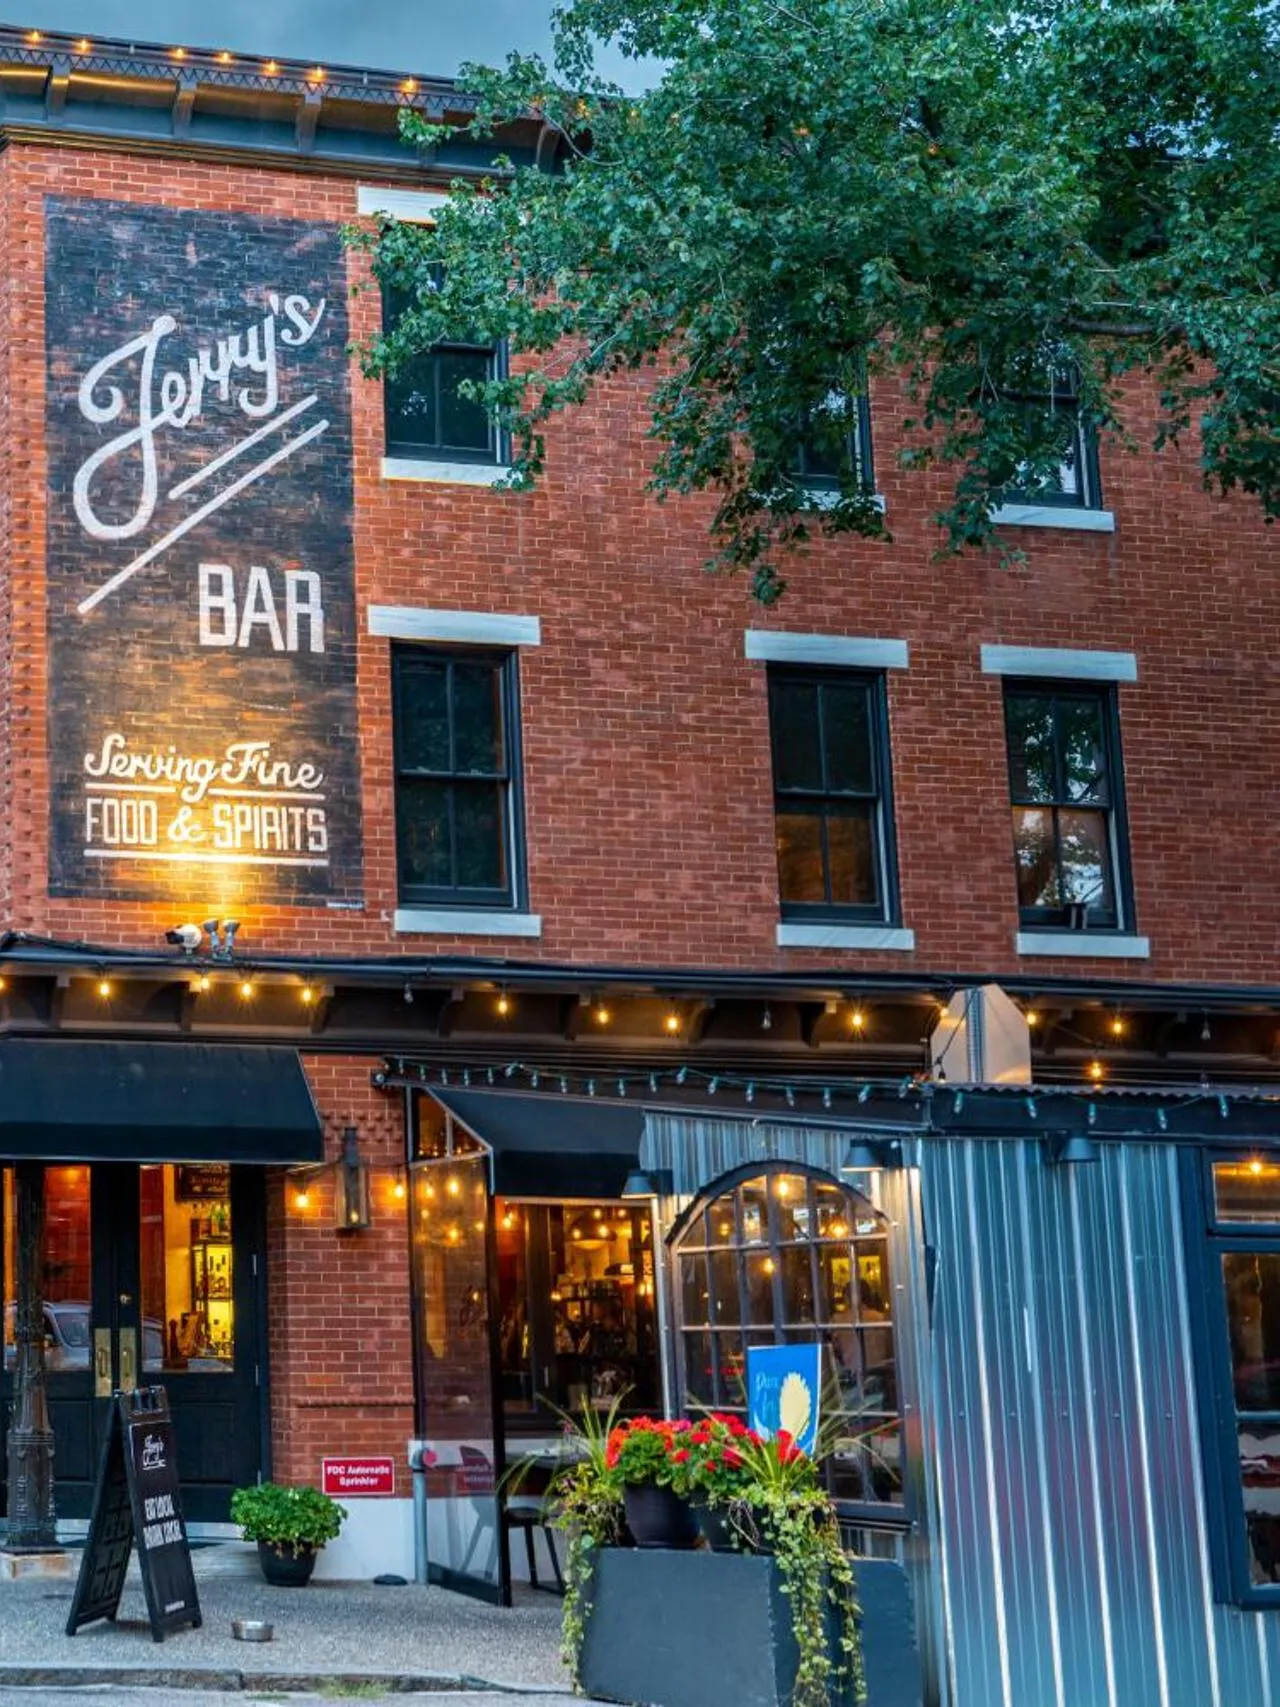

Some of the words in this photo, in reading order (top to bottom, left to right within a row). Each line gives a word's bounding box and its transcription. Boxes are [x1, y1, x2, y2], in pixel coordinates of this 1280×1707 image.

[73, 294, 326, 540] Jerry's
[198, 562, 325, 654] BAR
[84, 733, 218, 804] Serving
[220, 740, 324, 790] Fine
[85, 798, 158, 845] FOOD
[167, 804, 207, 844] &
[212, 803, 329, 852] SPIRITS
[327, 1466, 345, 1475] FDC
